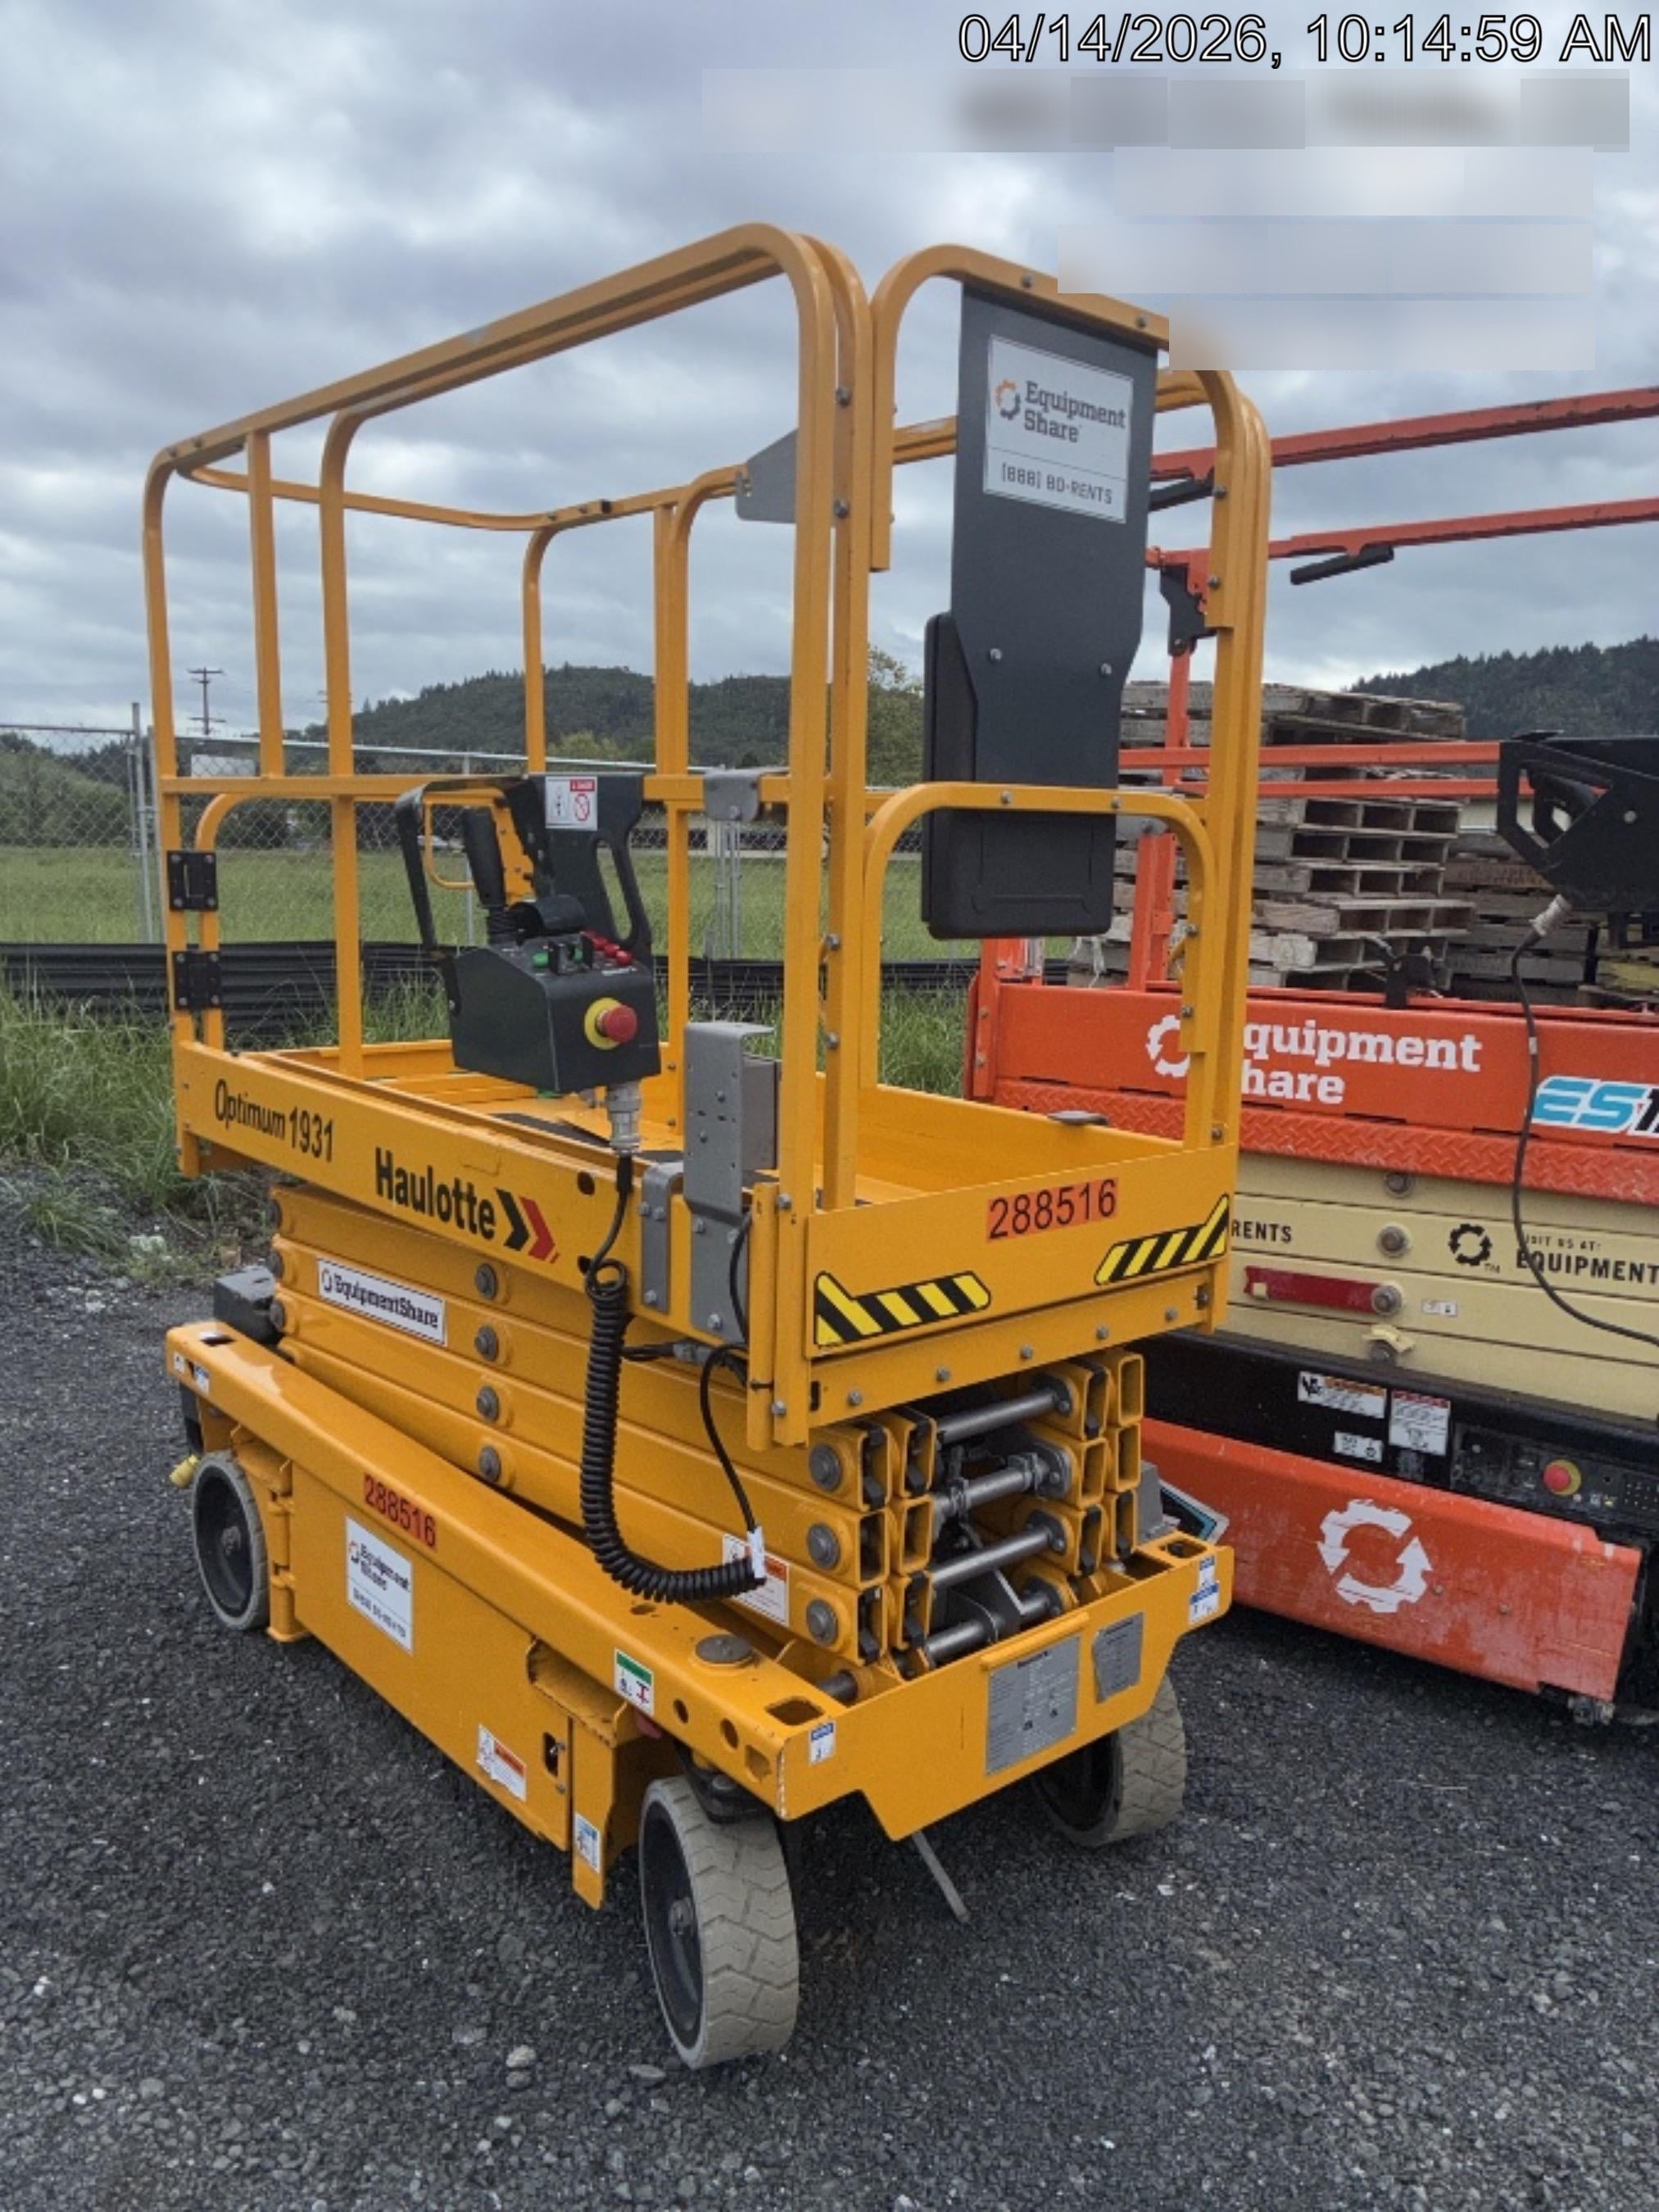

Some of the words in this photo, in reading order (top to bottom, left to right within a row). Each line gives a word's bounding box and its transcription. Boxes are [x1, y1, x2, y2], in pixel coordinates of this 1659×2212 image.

[1024, 410, 1079, 443] Share
[1025, 380, 1126, 428] Equipment
[1243, 1020, 1482, 1072] quipment
[1241, 1058, 1344, 1104] hare
[215, 1078, 286, 1141] Optimum
[289, 1105, 333, 1163] 1931
[375, 1146, 496, 1240] Haulotte
[989, 1178, 1117, 1240] 288516
[333, 1273, 439, 1329] EquipmentShare
[365, 1474, 437, 1548] 288516
